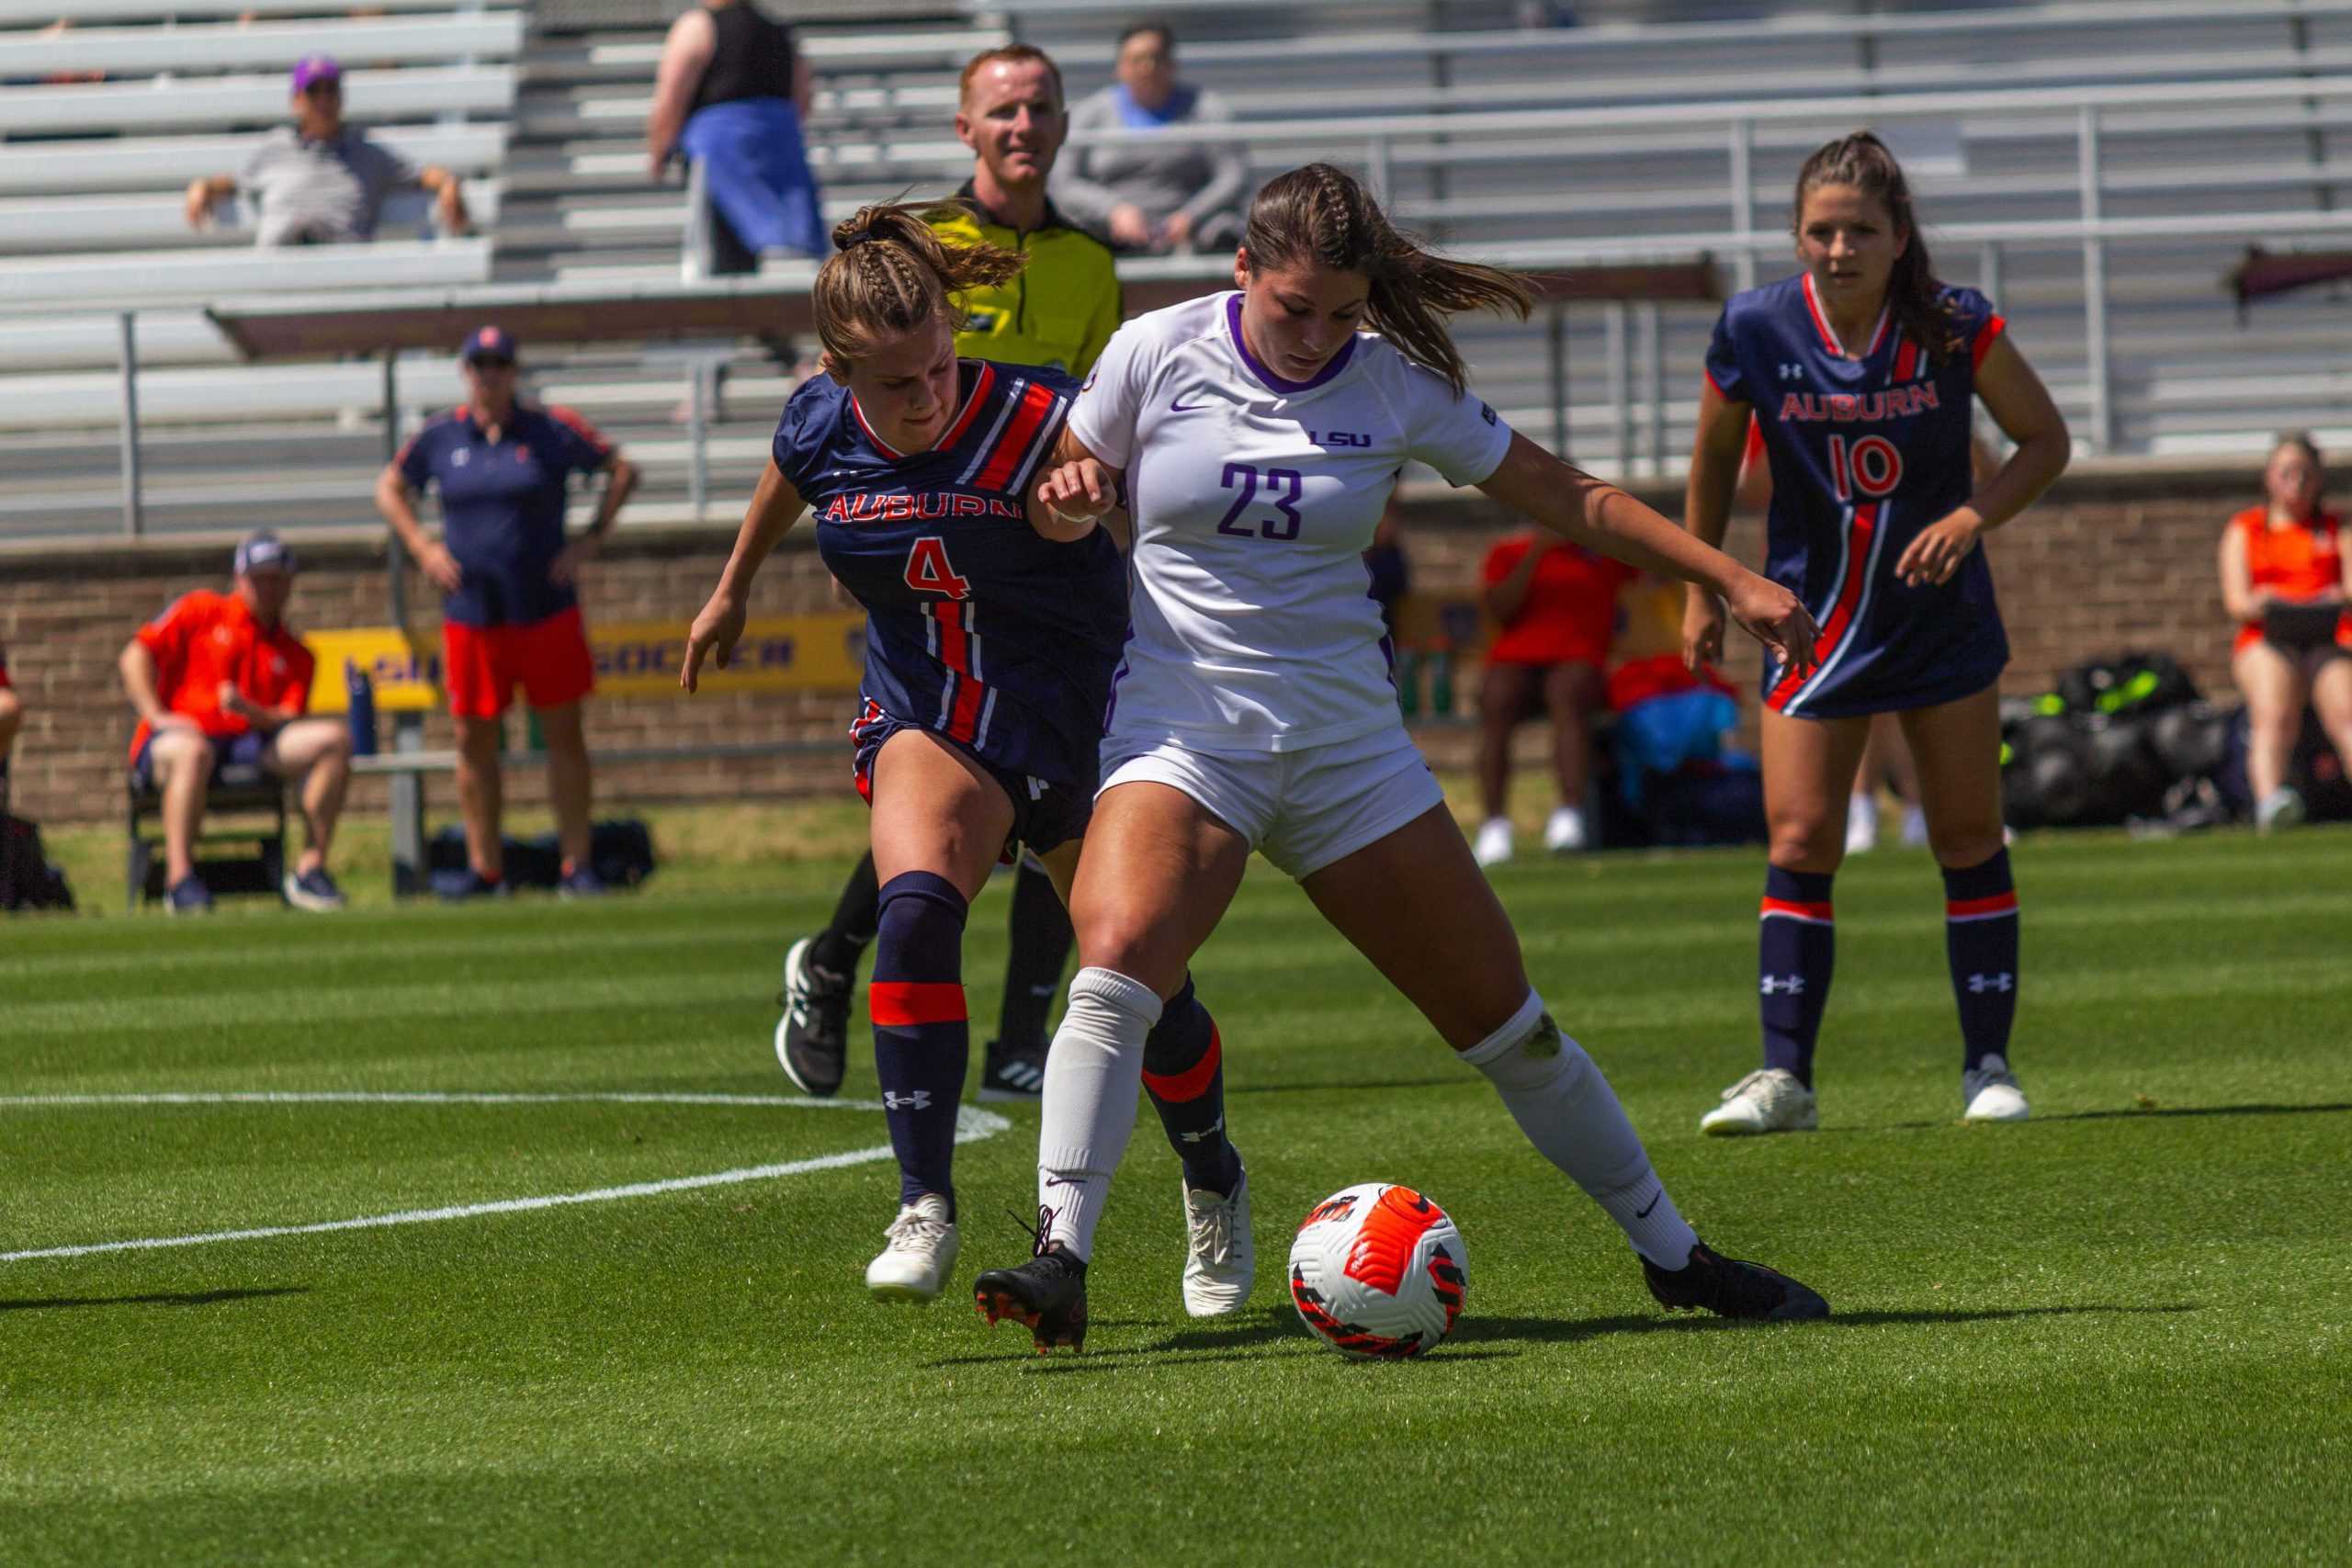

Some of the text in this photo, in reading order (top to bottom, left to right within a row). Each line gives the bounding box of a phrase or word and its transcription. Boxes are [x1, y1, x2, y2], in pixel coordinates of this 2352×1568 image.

[1779, 380, 1939, 422] AUBURN
[1308, 431, 1372, 447] LSU
[1828, 434, 1903, 502] 10
[1217, 462, 1302, 541] 23
[904, 536, 971, 599] 4
